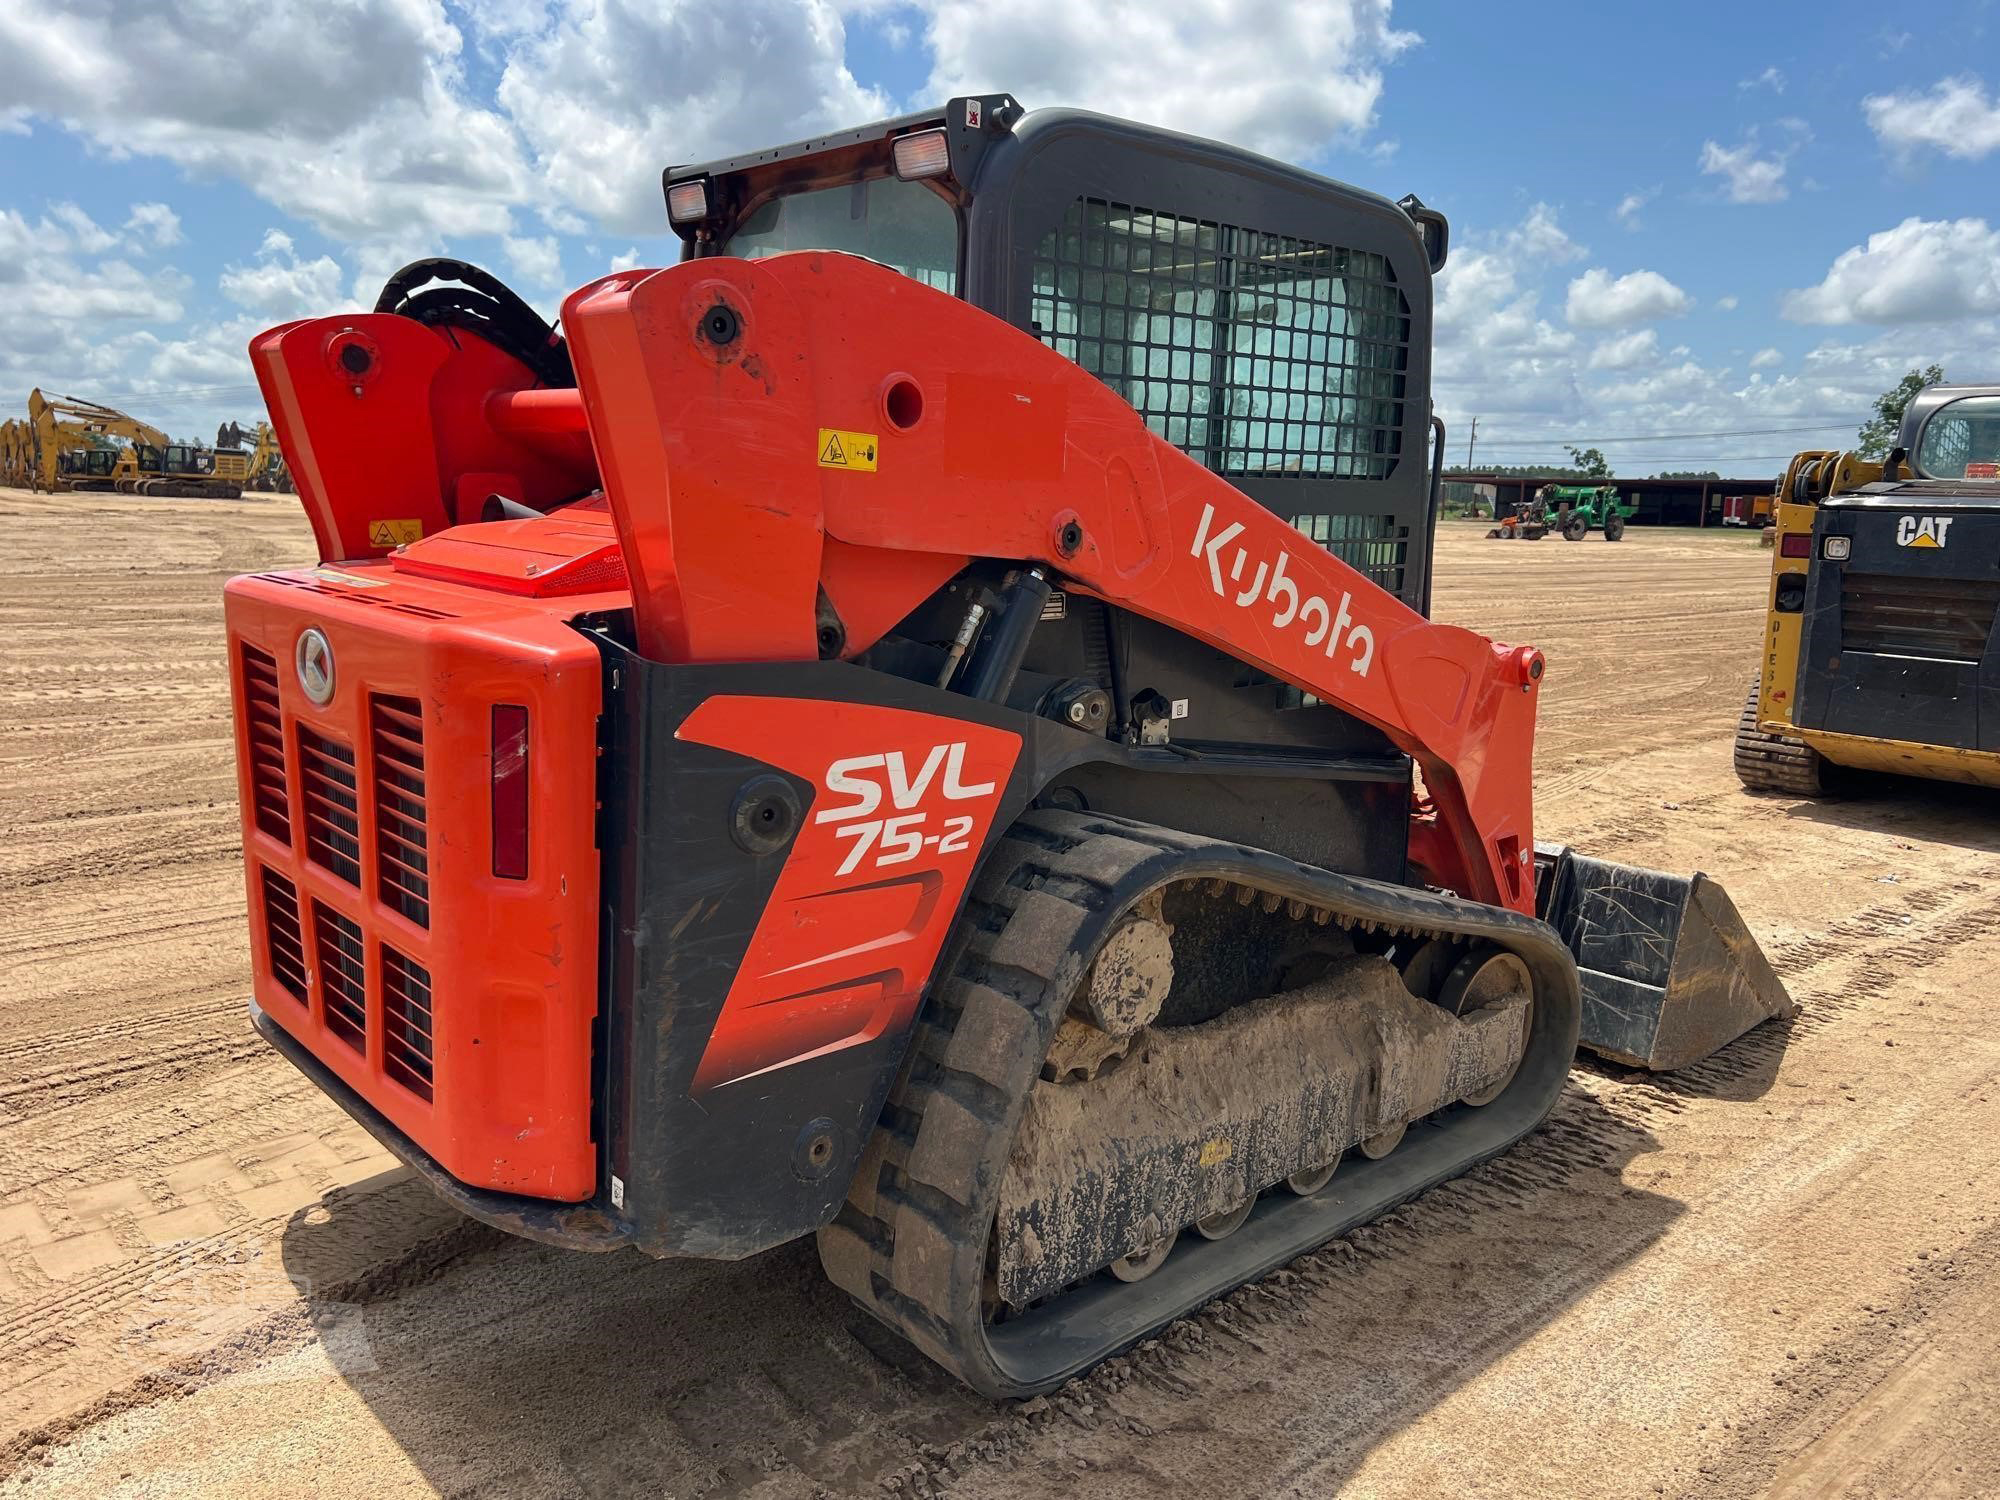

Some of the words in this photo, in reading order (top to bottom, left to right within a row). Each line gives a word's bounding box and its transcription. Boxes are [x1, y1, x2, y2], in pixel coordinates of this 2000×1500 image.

[1896, 515, 1953, 548] CAT
[1190, 503, 1374, 678] Kubota
[815, 741, 996, 825] SVL
[834, 812, 974, 877] 75-2
